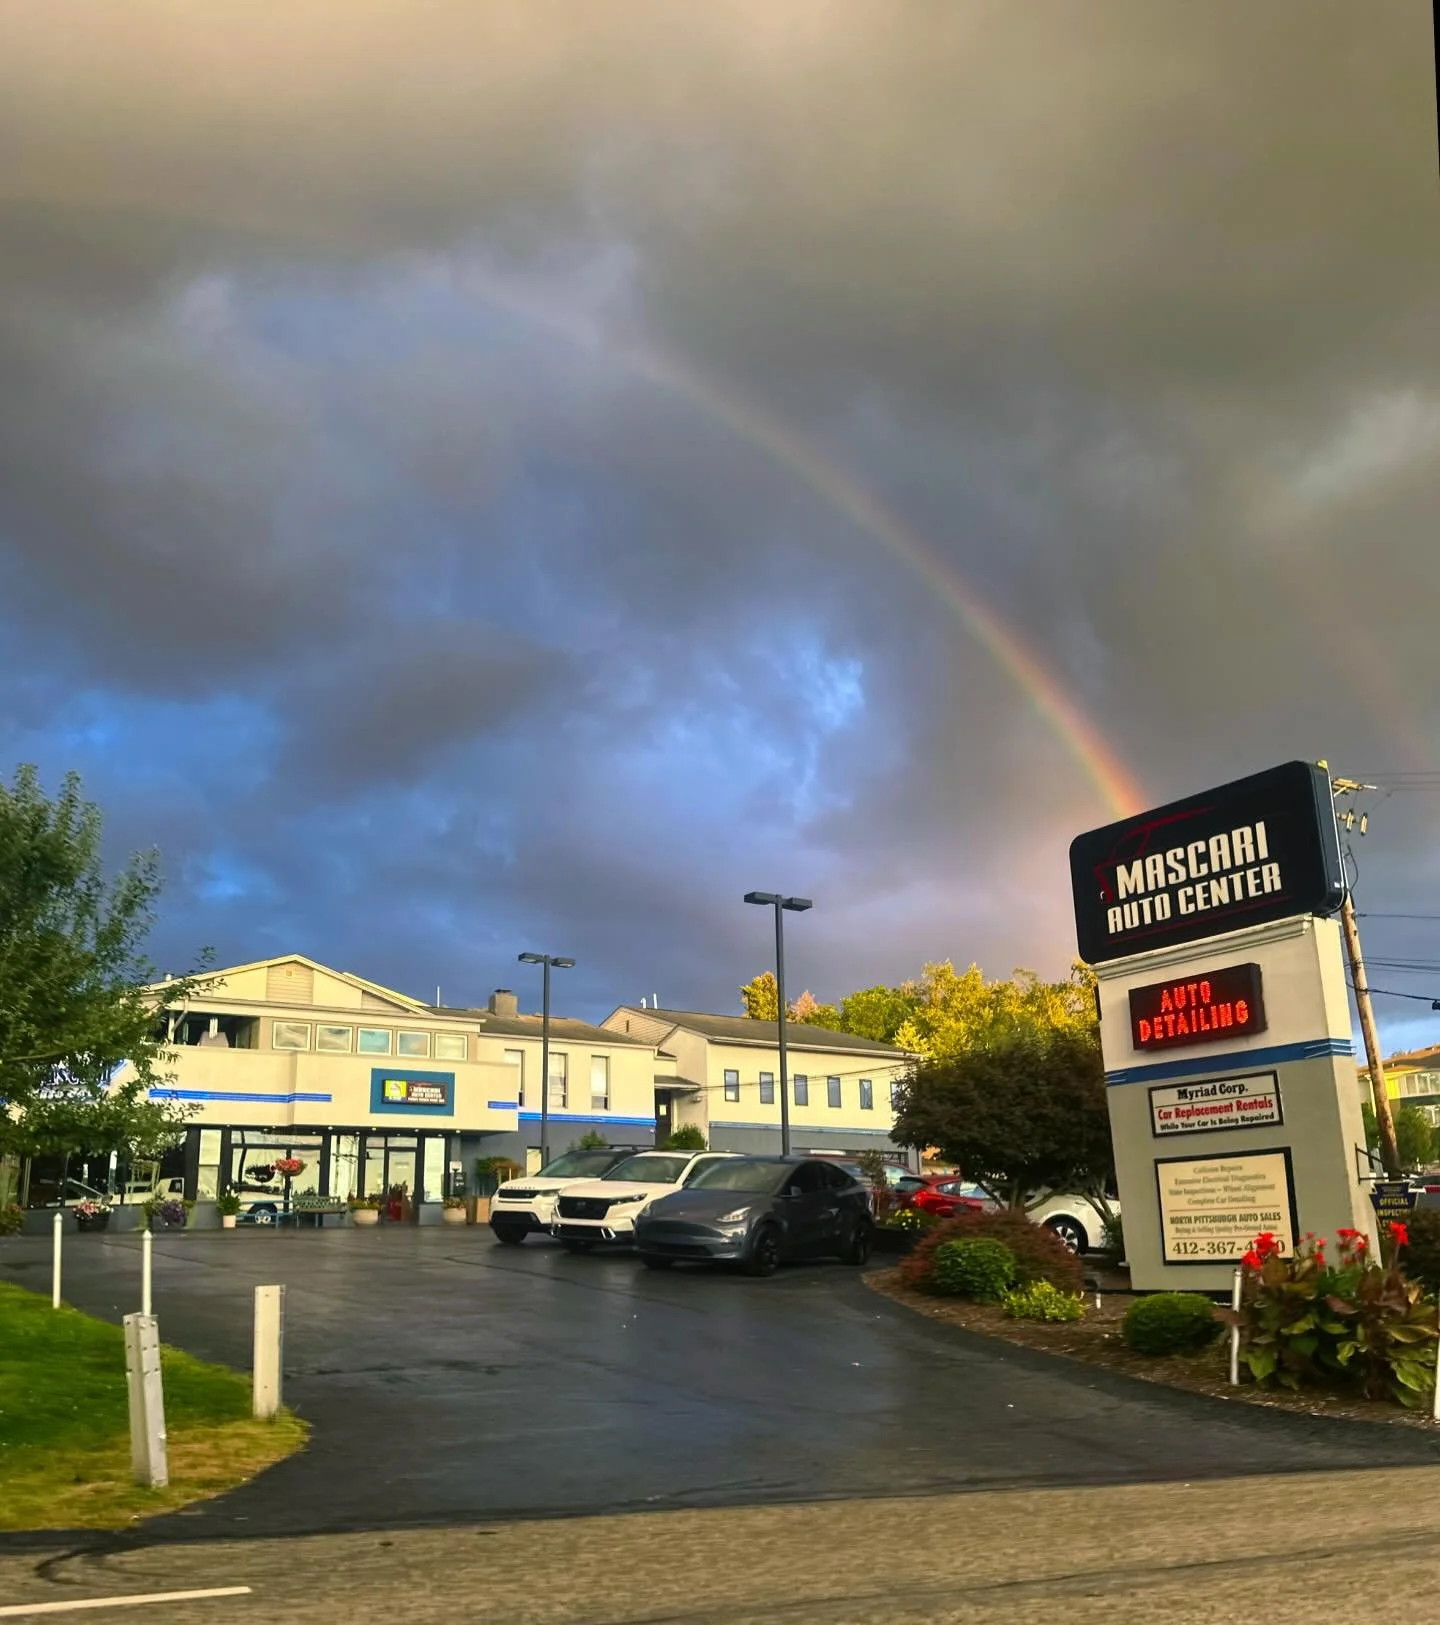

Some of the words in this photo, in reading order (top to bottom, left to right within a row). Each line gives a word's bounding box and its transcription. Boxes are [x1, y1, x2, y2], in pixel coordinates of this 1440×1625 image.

[1116, 821, 1269, 899] MASCARI
[1108, 894, 1170, 934] AUTO
[1178, 862, 1282, 915] CENTER
[1161, 981, 1211, 1012] AUTO
[1139, 1000, 1248, 1042] DETAILING
[1178, 1085, 1216, 1100] Myriad
[1219, 1083, 1248, 1095] Corp.
[1158, 1109, 1172, 1120] Car
[1175, 1102, 1233, 1119] Replacement
[1236, 1096, 1273, 1110] Rentals
[1160, 1122, 1179, 1131] While
[1198, 1119, 1208, 1127] Car
[1219, 1116, 1239, 1125] Being
[1241, 1112, 1274, 1122] Repaired
[1239, 1213, 1258, 1222] AUTO
[1260, 1212, 1281, 1220] SALES
[1173, 1240, 1285, 1255] 412-367-40
